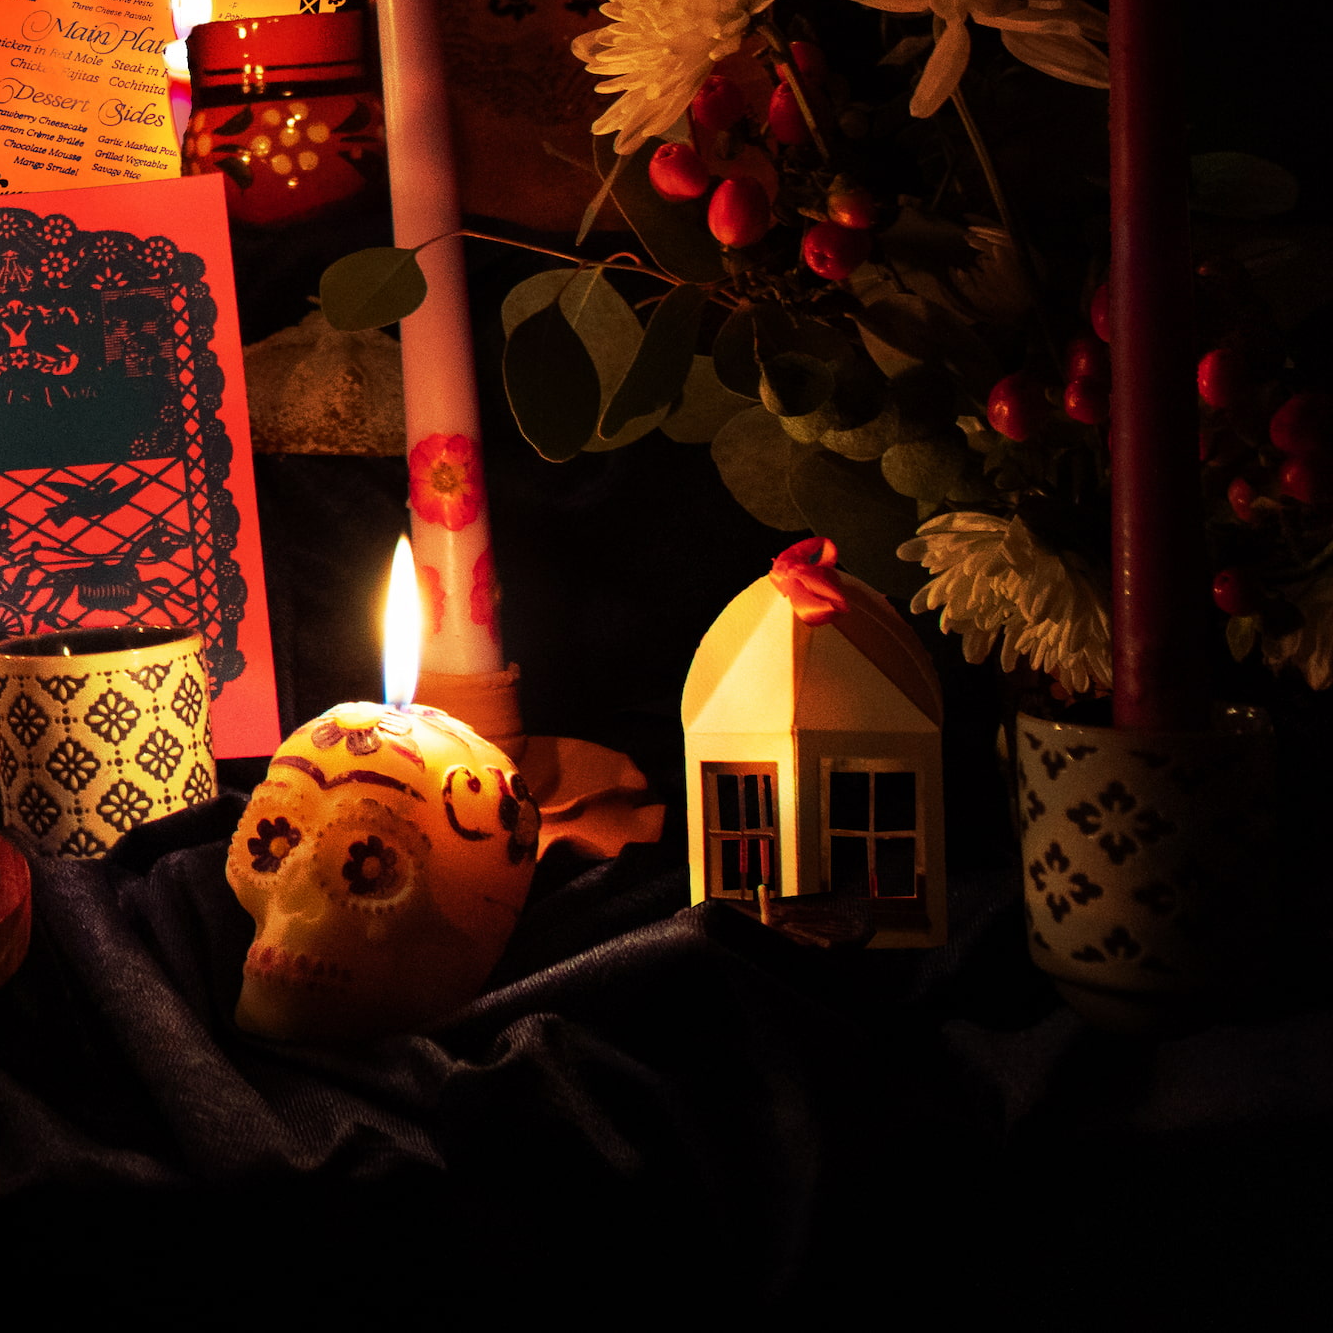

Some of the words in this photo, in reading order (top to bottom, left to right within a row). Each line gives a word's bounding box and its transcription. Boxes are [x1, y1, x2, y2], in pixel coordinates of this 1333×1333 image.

[72, 1, 93, 12] Three
[95, 5, 123, 17] Cheese
[123, 10, 152, 22] Ravioli
[21, 10, 110, 46] Main
[34, 44, 47, 56] in
[74, 52, 104, 66] Mole
[111, 59, 145, 74] Steak
[146, 66, 159, 77] in
[109, 76, 166, 95] Cochinita
[98, 98, 165, 127] Sides
[38, 116, 88, 133] Cheesecake
[4, 138, 47, 154] Chocolate
[48, 148, 82, 162] Mousse
[97, 135, 124, 147] Garlic
[124, 140, 159, 153] Mashed
[13, 156, 45, 170] Mango
[45, 162, 80, 176] Strudel
[94, 149, 125, 162] Grilled
[126, 155, 169, 170] Vegetables
[91, 163, 122, 177] Savage
[122, 169, 142, 180] Rice
